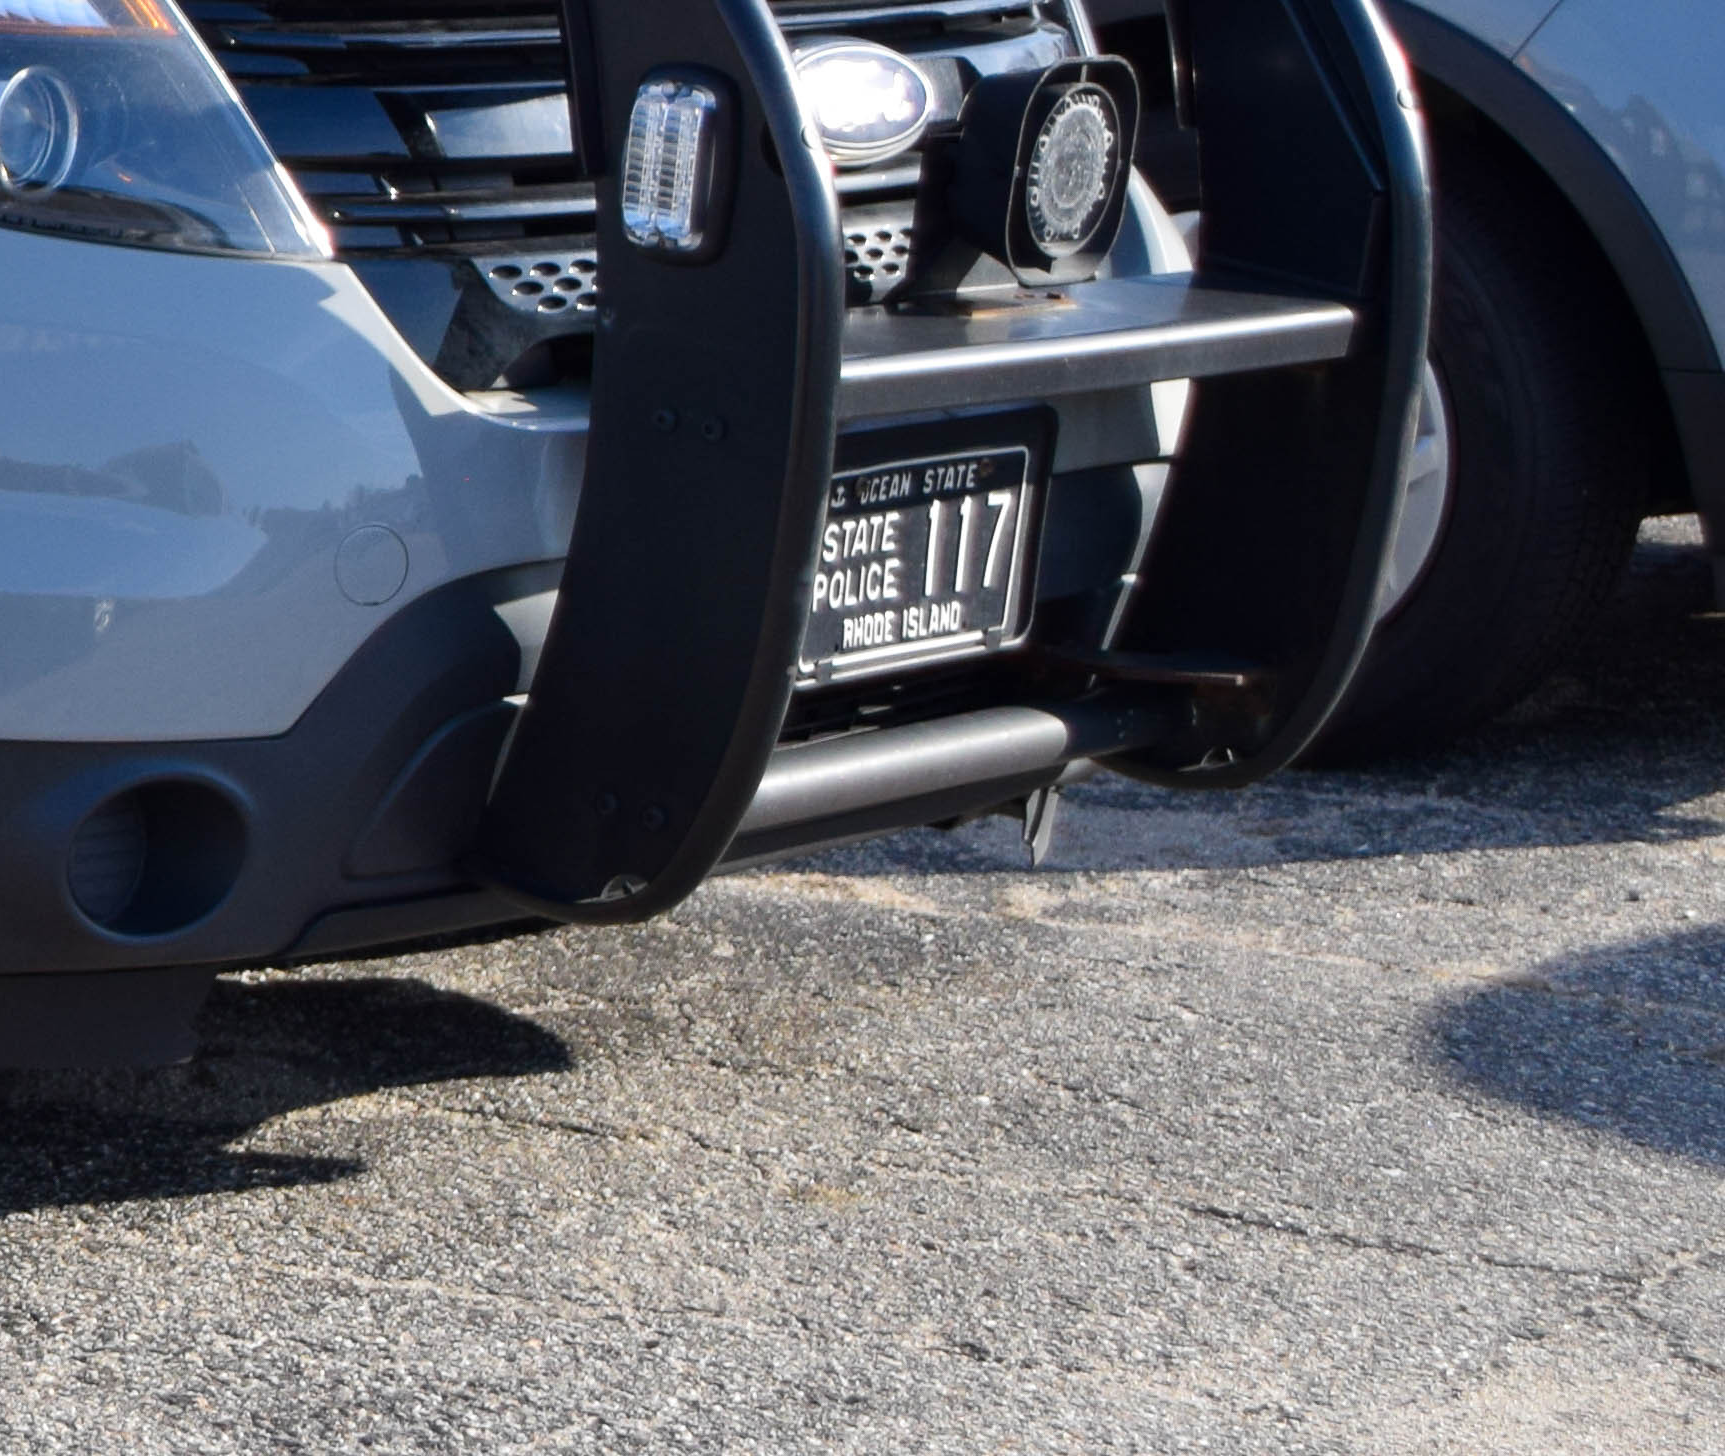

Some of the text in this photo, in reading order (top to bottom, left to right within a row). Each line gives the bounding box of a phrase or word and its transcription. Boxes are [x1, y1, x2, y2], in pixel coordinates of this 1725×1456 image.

[860, 463, 977, 506] OCEAN STATE
[822, 512, 900, 562] STATE
[924, 492, 1012, 597] 117
[812, 558, 900, 612] POLICE
[843, 601, 962, 649] RHODE ISLAND
